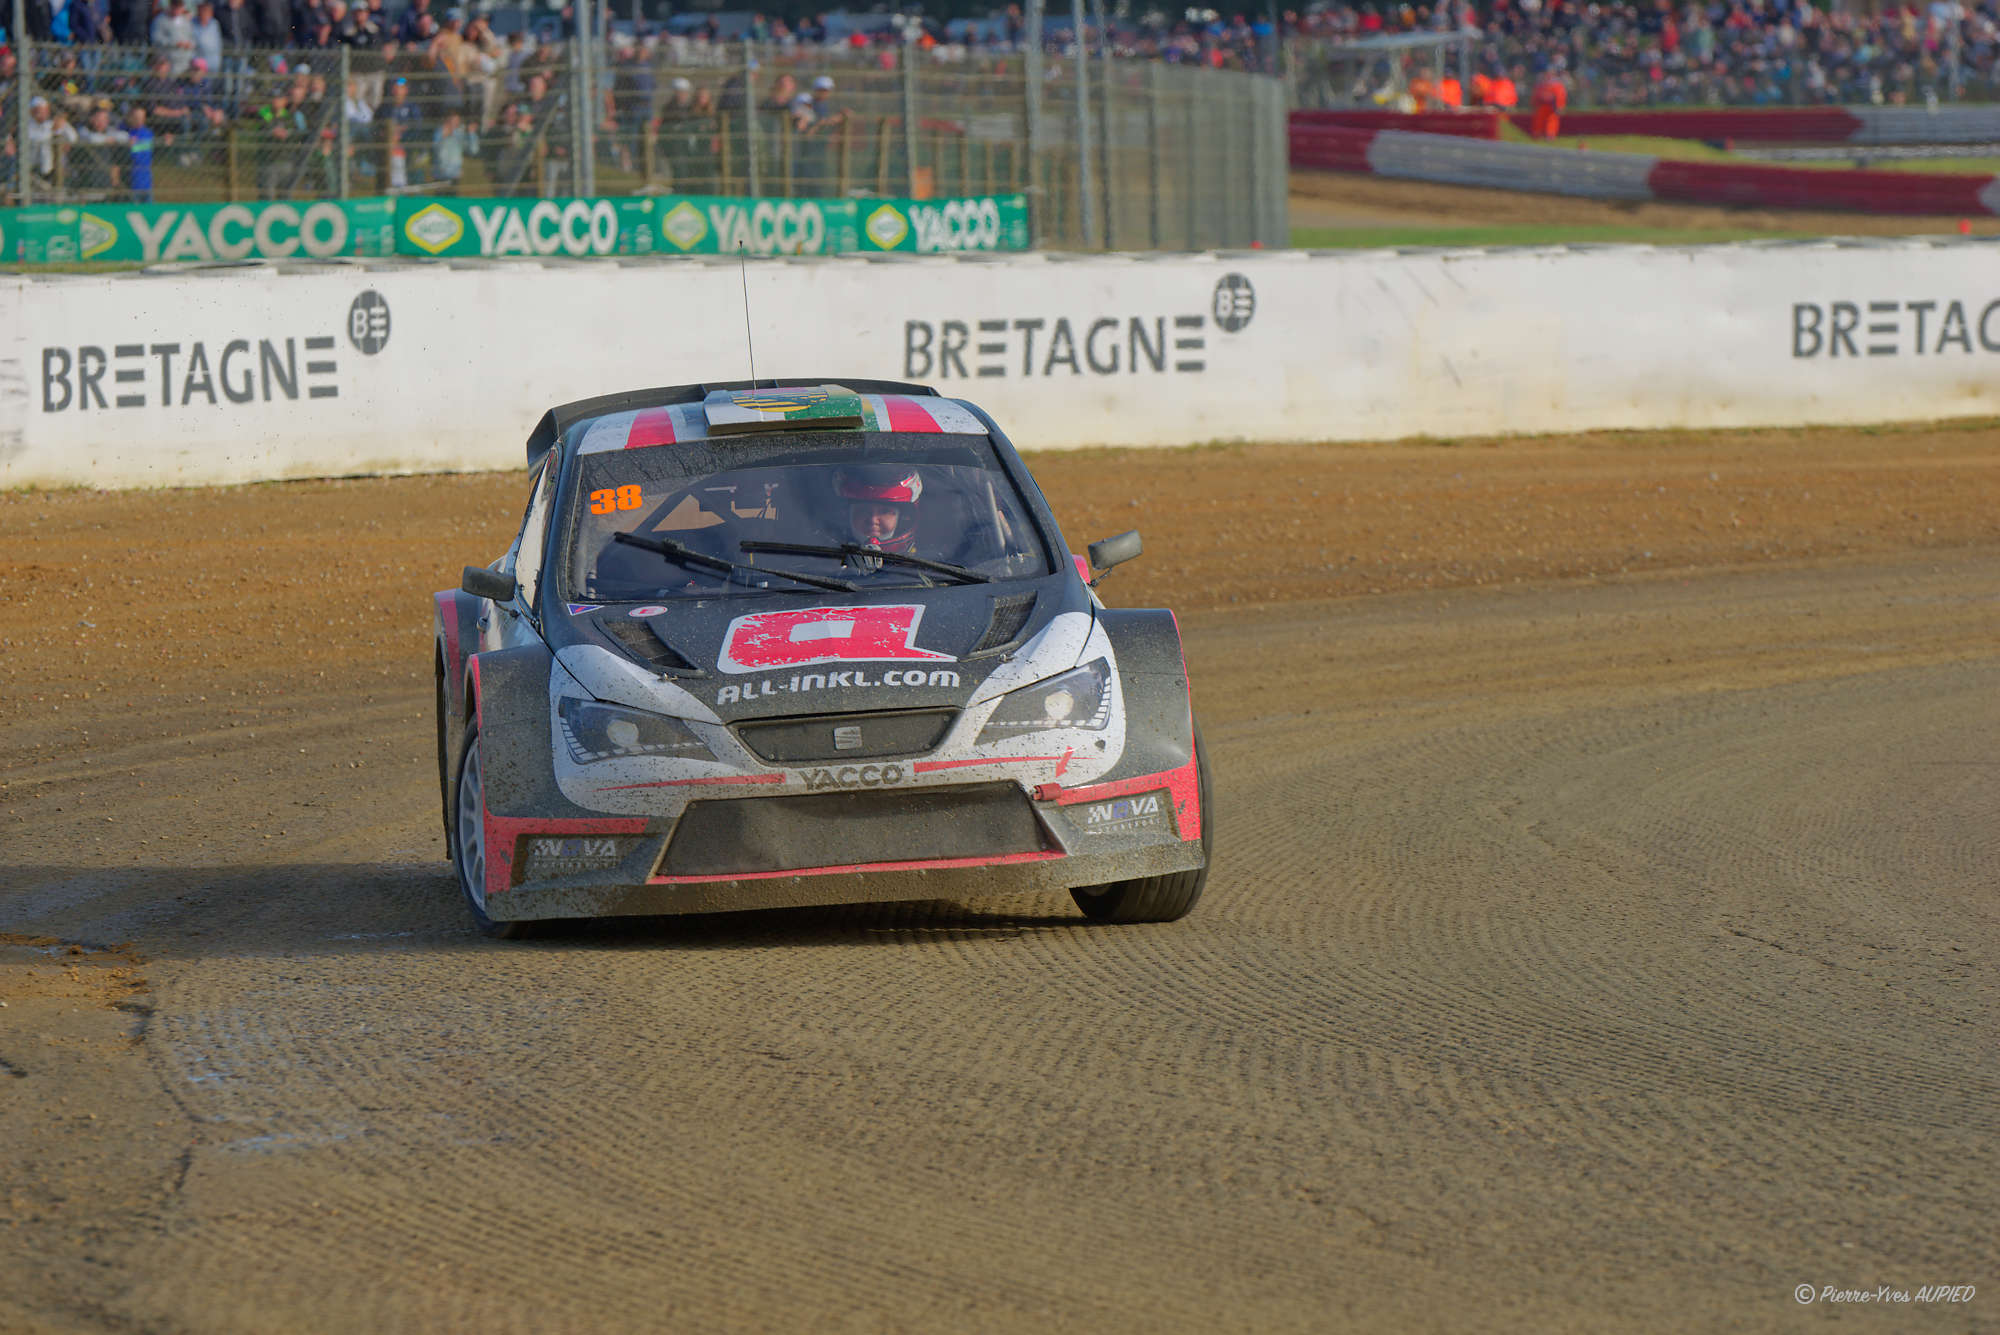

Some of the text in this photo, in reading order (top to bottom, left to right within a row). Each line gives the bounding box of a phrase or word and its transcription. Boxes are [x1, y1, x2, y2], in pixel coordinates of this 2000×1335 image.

[126, 202, 348, 261] YACCO
[469, 200, 618, 256] YACCO
[709, 201, 824, 253] YACCO
[909, 198, 999, 250] YACCO
[905, 315, 1206, 378] BRETAGNE
[42, 336, 338, 413] BRETAGNE
[590, 484, 642, 514] 38
[800, 764, 902, 791] YACCO
